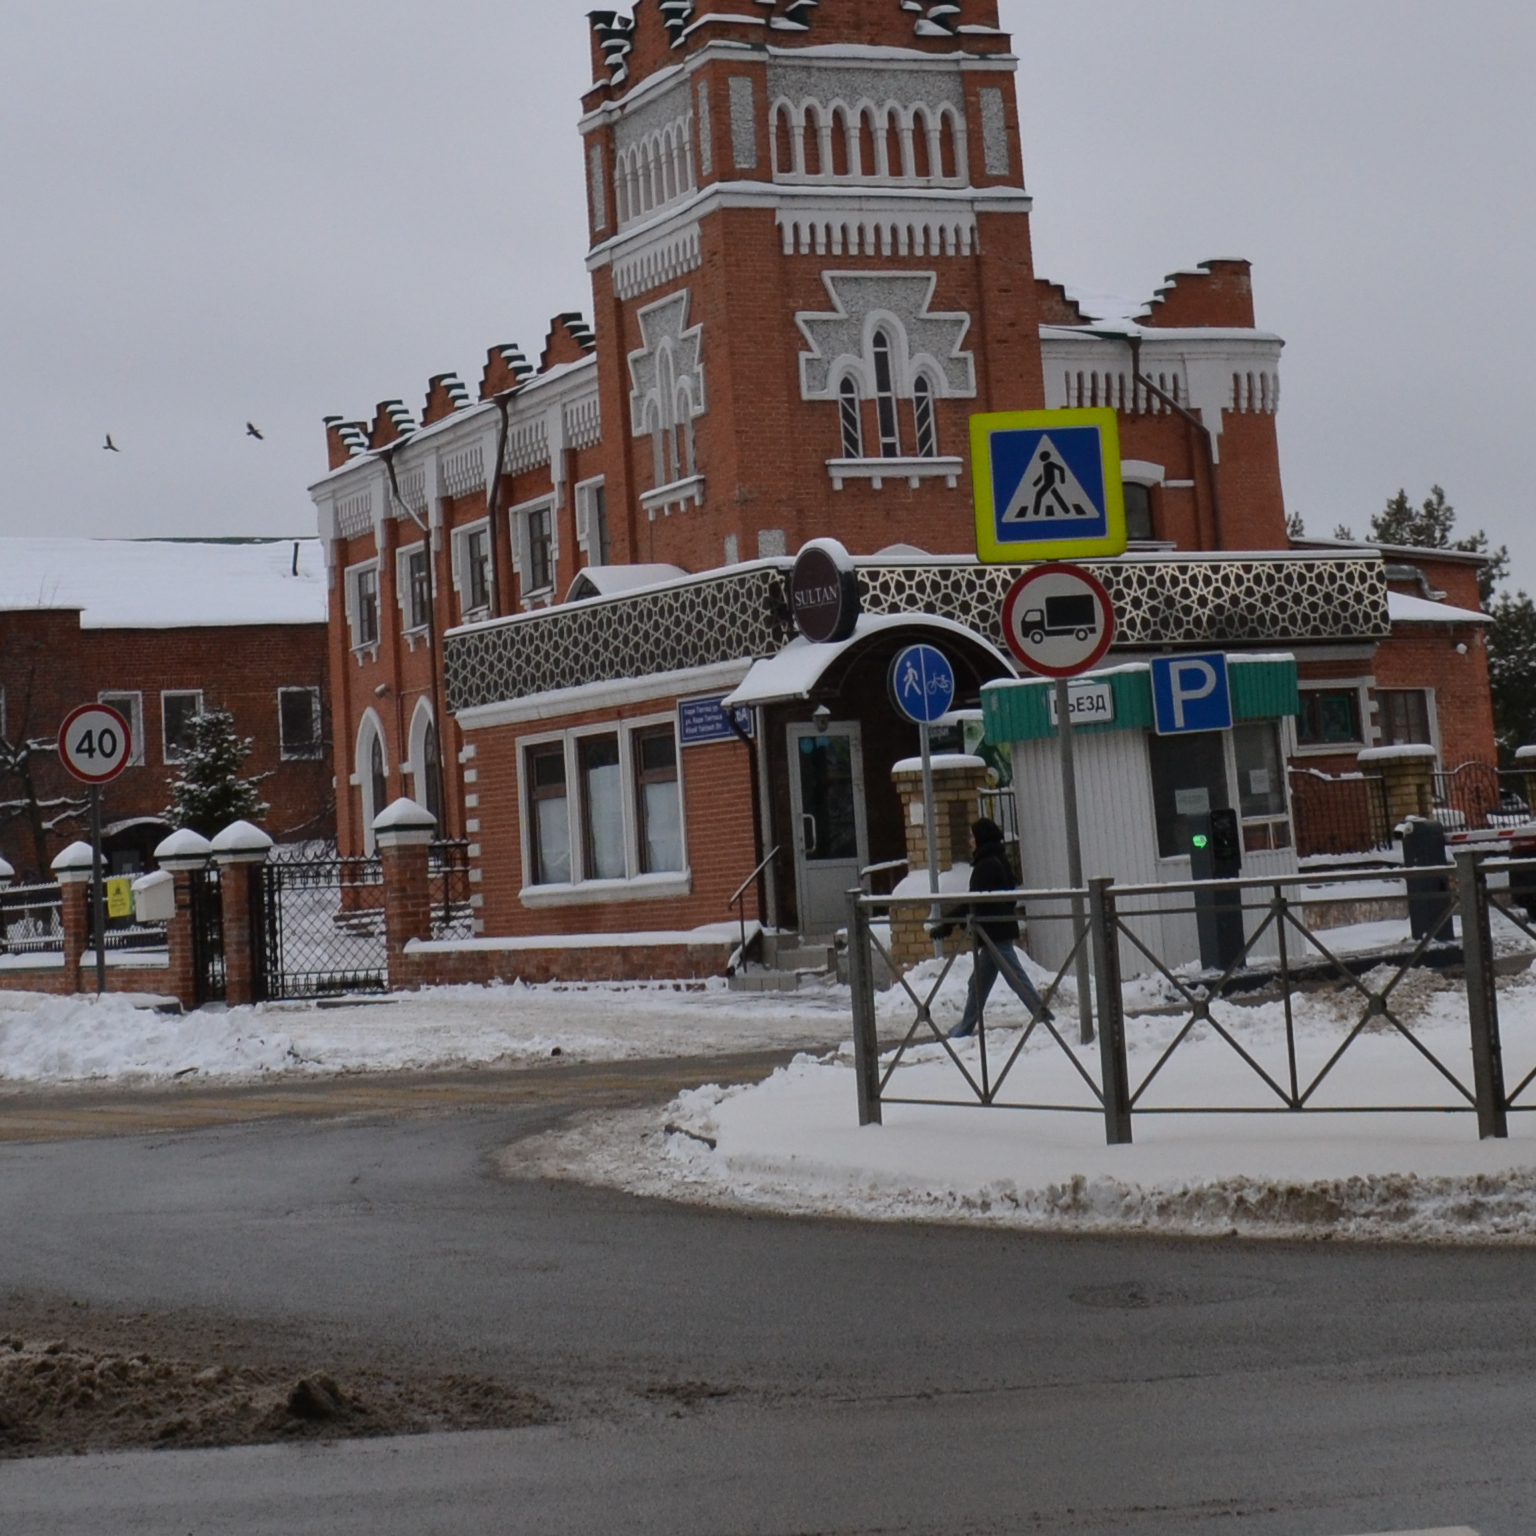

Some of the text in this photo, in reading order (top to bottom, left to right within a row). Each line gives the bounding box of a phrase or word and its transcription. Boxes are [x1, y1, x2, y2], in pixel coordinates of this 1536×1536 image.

[795, 585, 837, 607] SULTAN
[1169, 659, 1217, 728] P
[75, 727, 117, 759] 40
